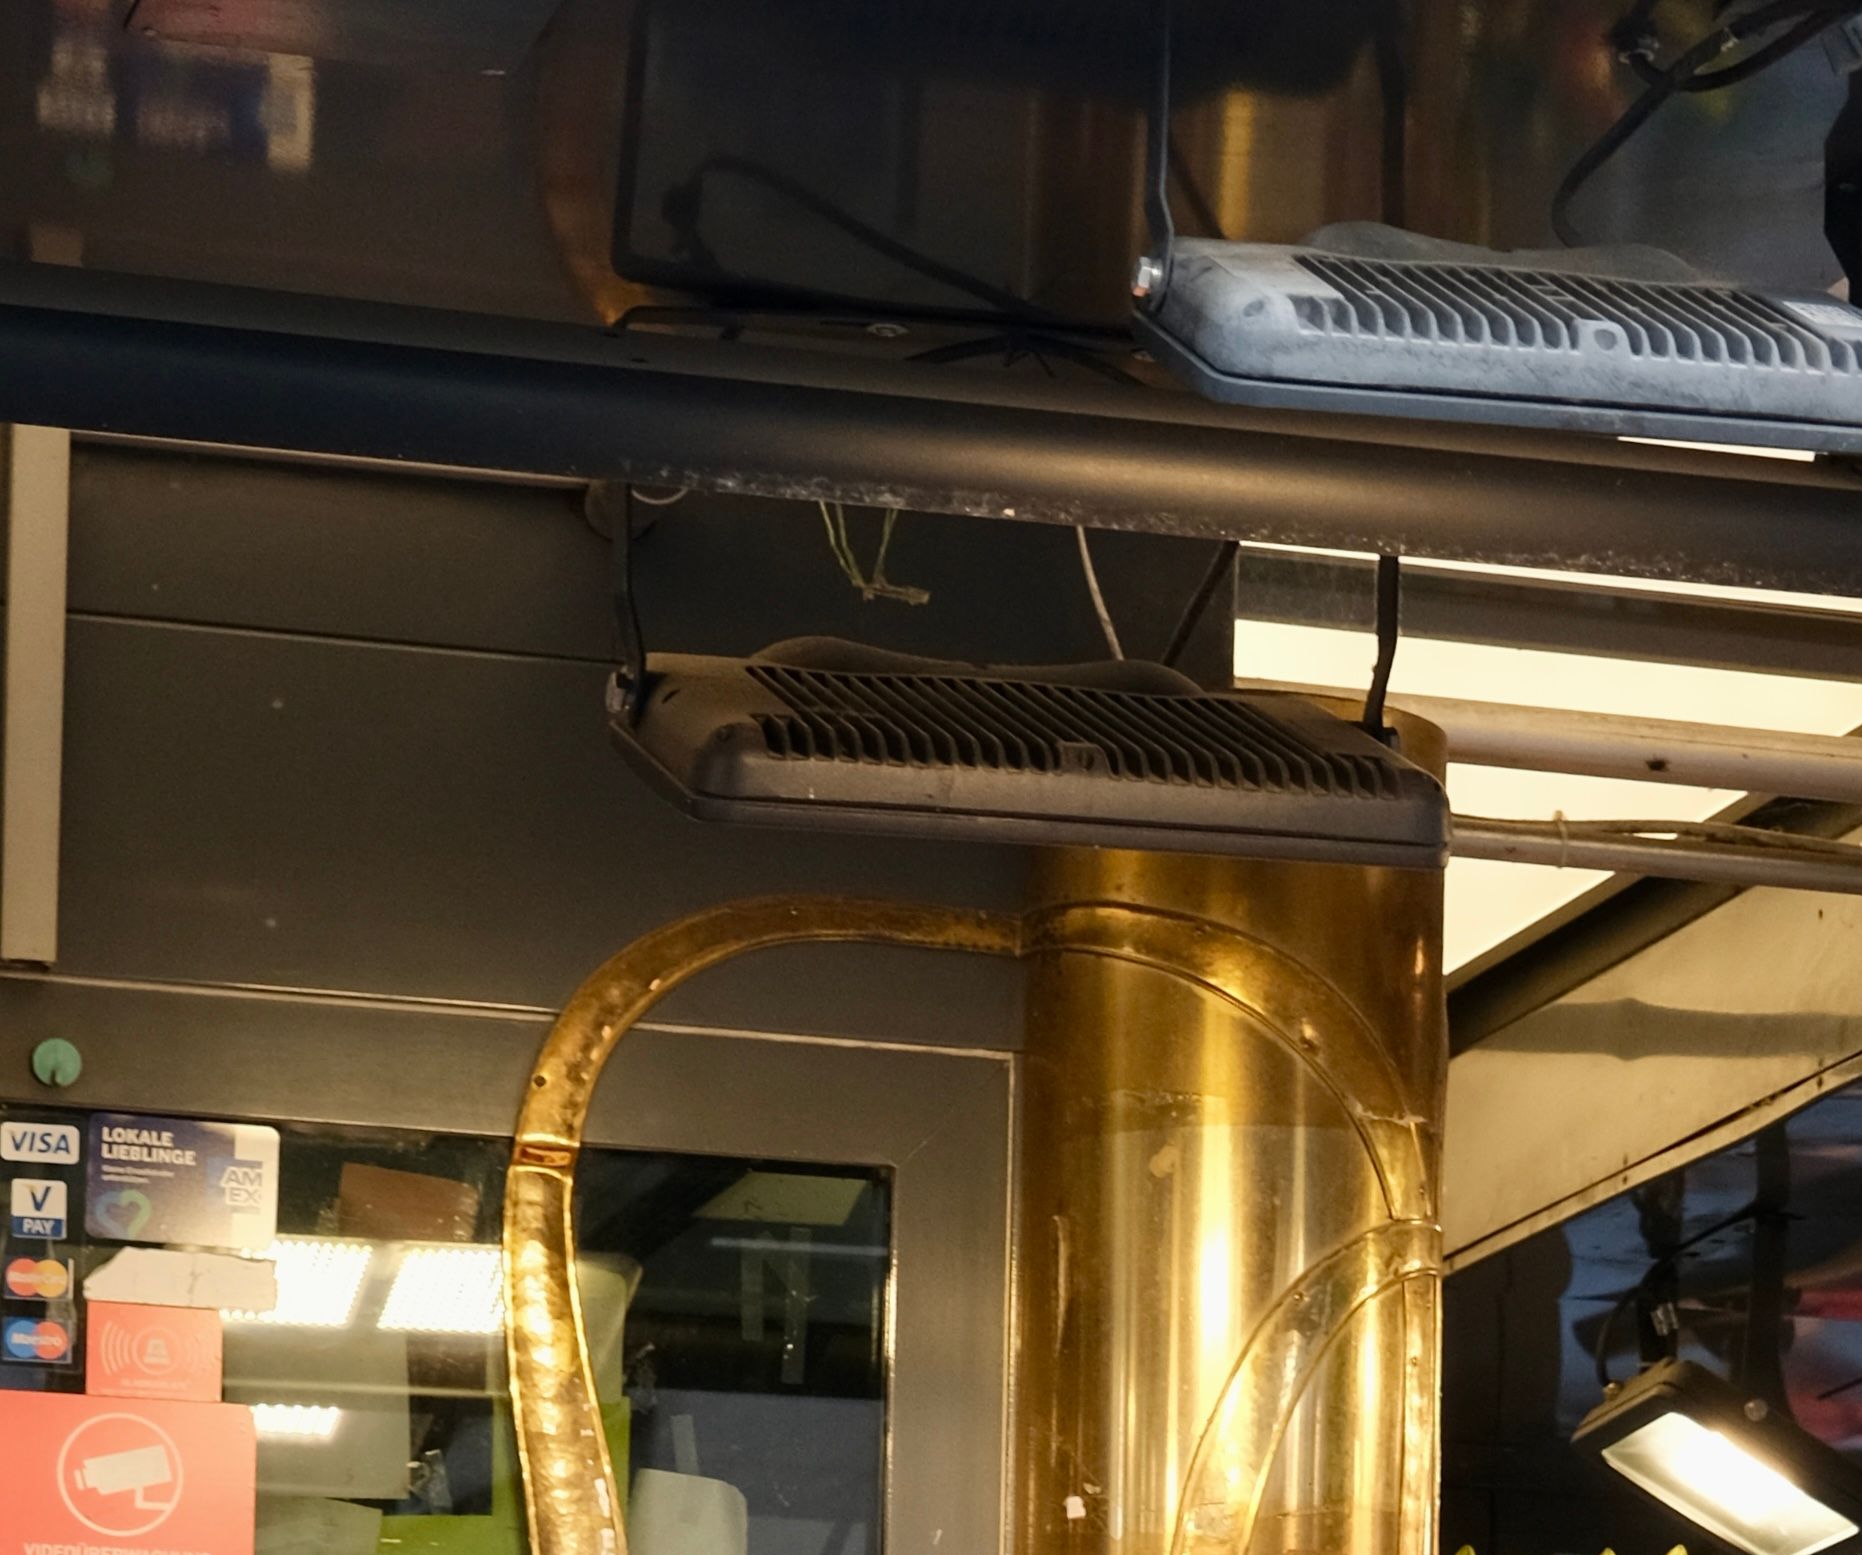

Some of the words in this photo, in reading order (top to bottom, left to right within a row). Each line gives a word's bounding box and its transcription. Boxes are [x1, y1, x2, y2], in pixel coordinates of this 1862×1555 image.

[8, 1129, 70, 1154] VISA
[102, 1126, 175, 1148] LOKALE
[101, 1143, 197, 1167] LIEBLINGE
[222, 1168, 263, 1187] AM
[24, 1184, 51, 1212] V
[229, 1187, 261, 1204] EX
[22, 1218, 55, 1235] PAY
